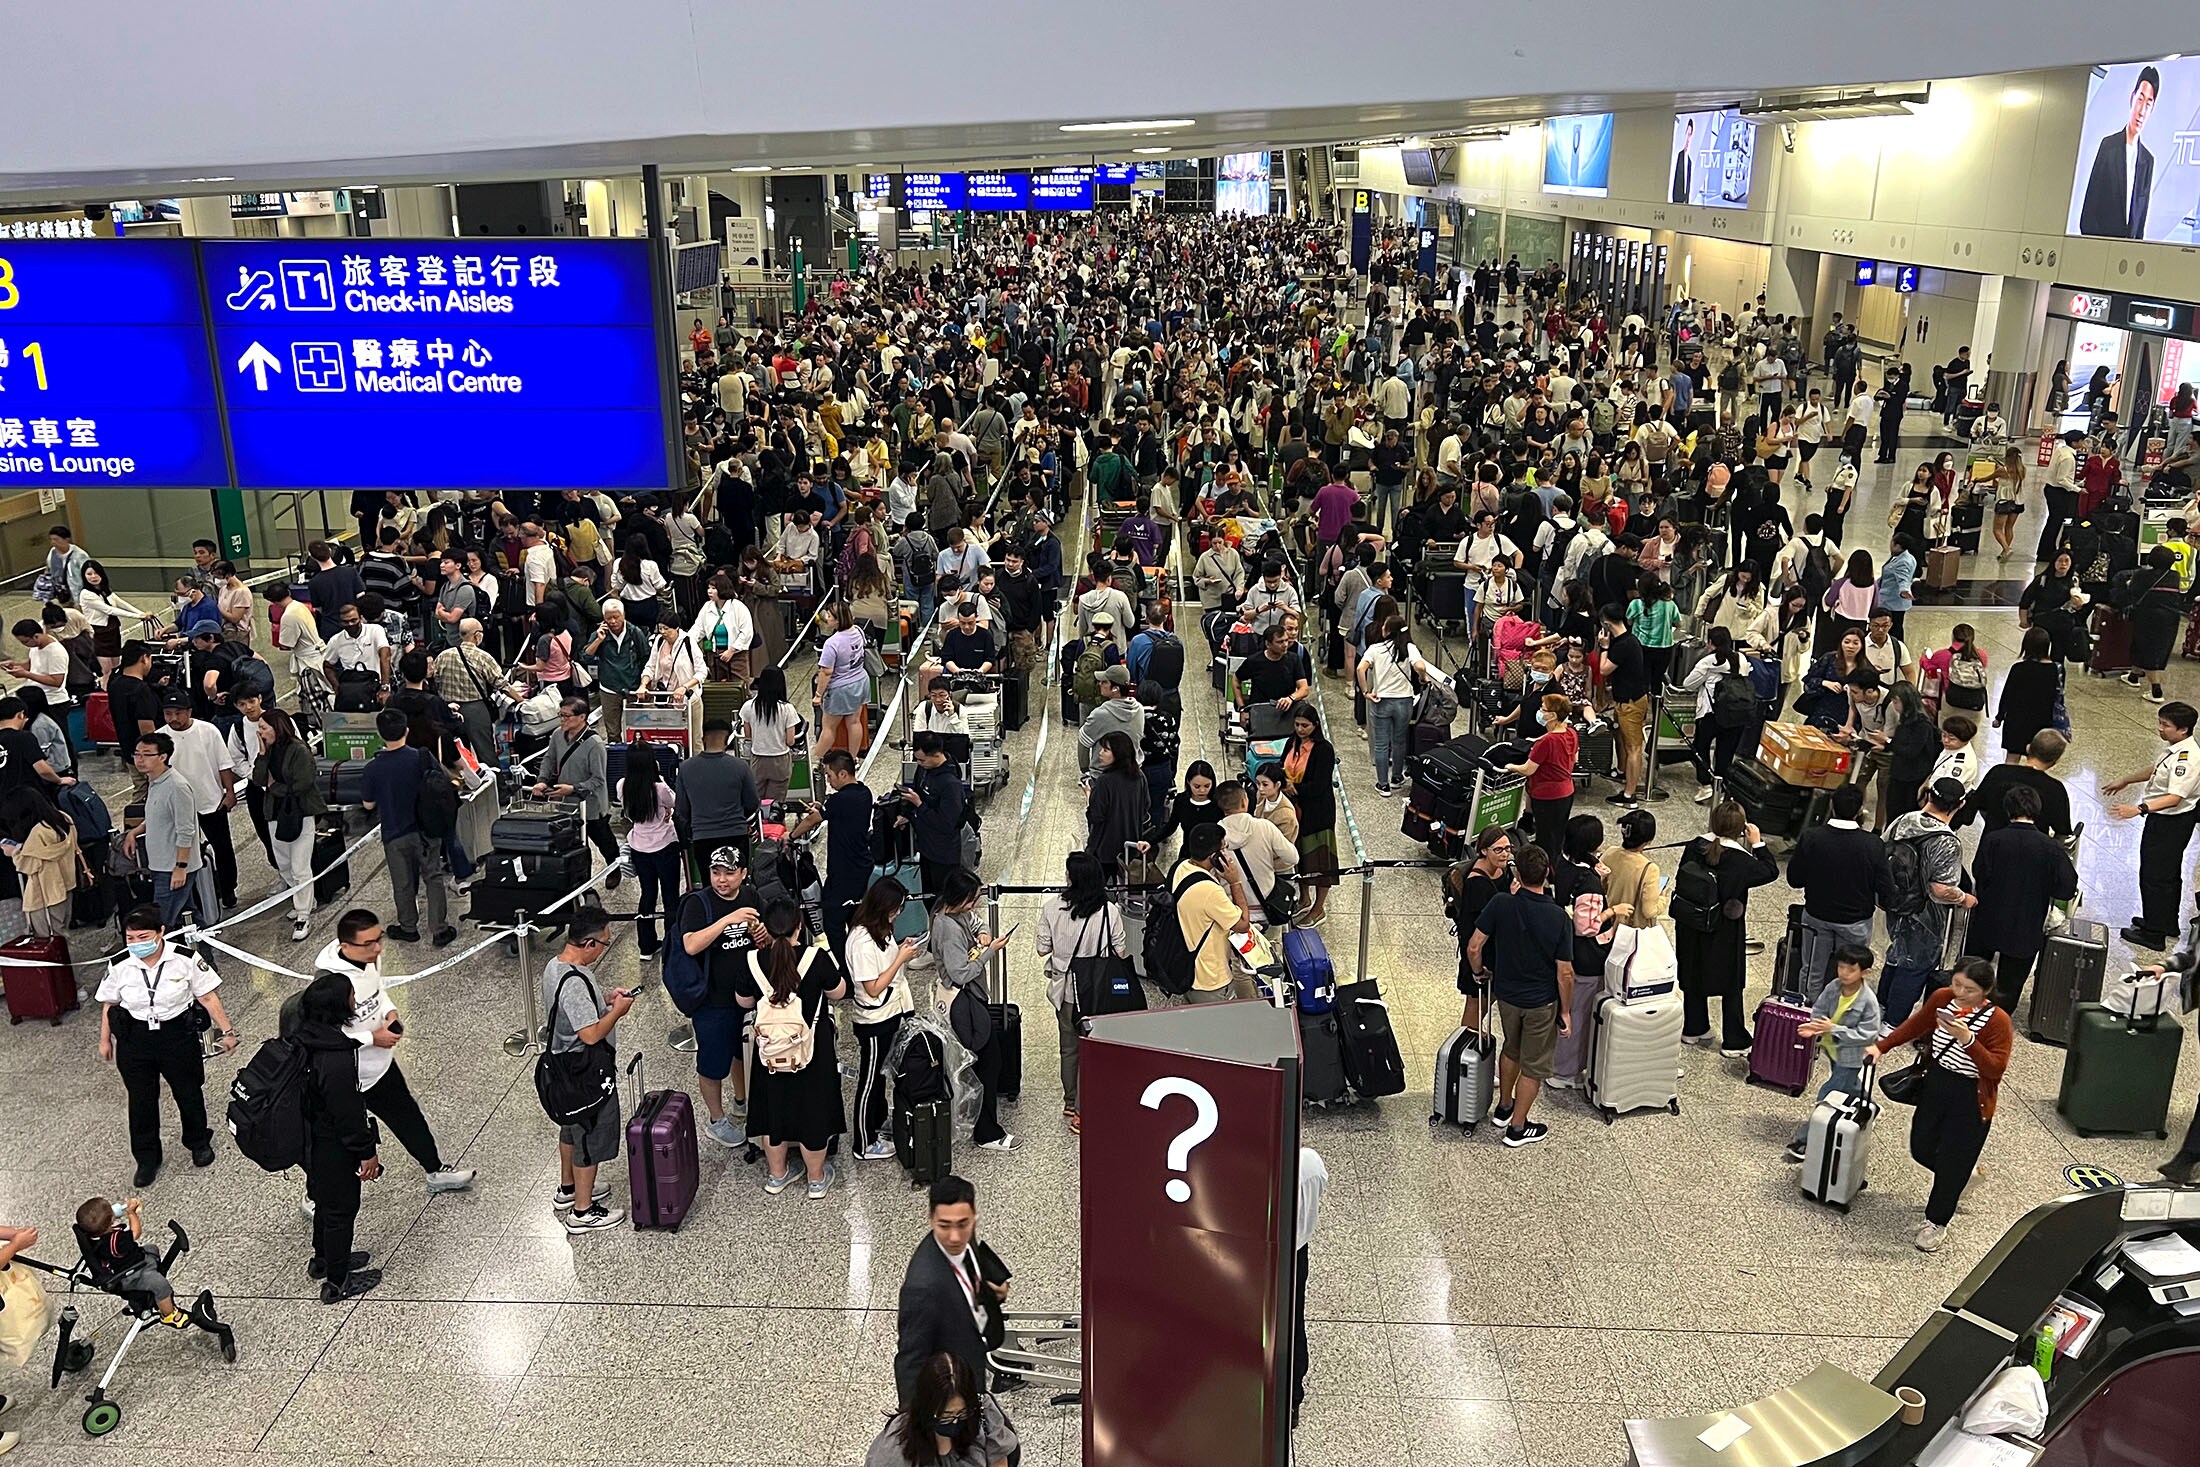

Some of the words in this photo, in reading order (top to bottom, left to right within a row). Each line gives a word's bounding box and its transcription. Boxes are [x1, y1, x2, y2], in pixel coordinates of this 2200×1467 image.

[1356, 191, 1368, 208] B
[342, 255, 560, 287] 旅客登記行段
[287, 271, 328, 300] T1
[345, 290, 441, 312] Check-in
[445, 290, 513, 312] Aisles
[23, 342, 48, 391] 1
[352, 338, 492, 369] 醫療中心
[355, 371, 442, 393] Medical
[448, 371, 522, 393] Centre
[0, 418, 100, 449] 候車室
[49, 453, 135, 478] Lounge
[722, 937, 751, 950] adida
